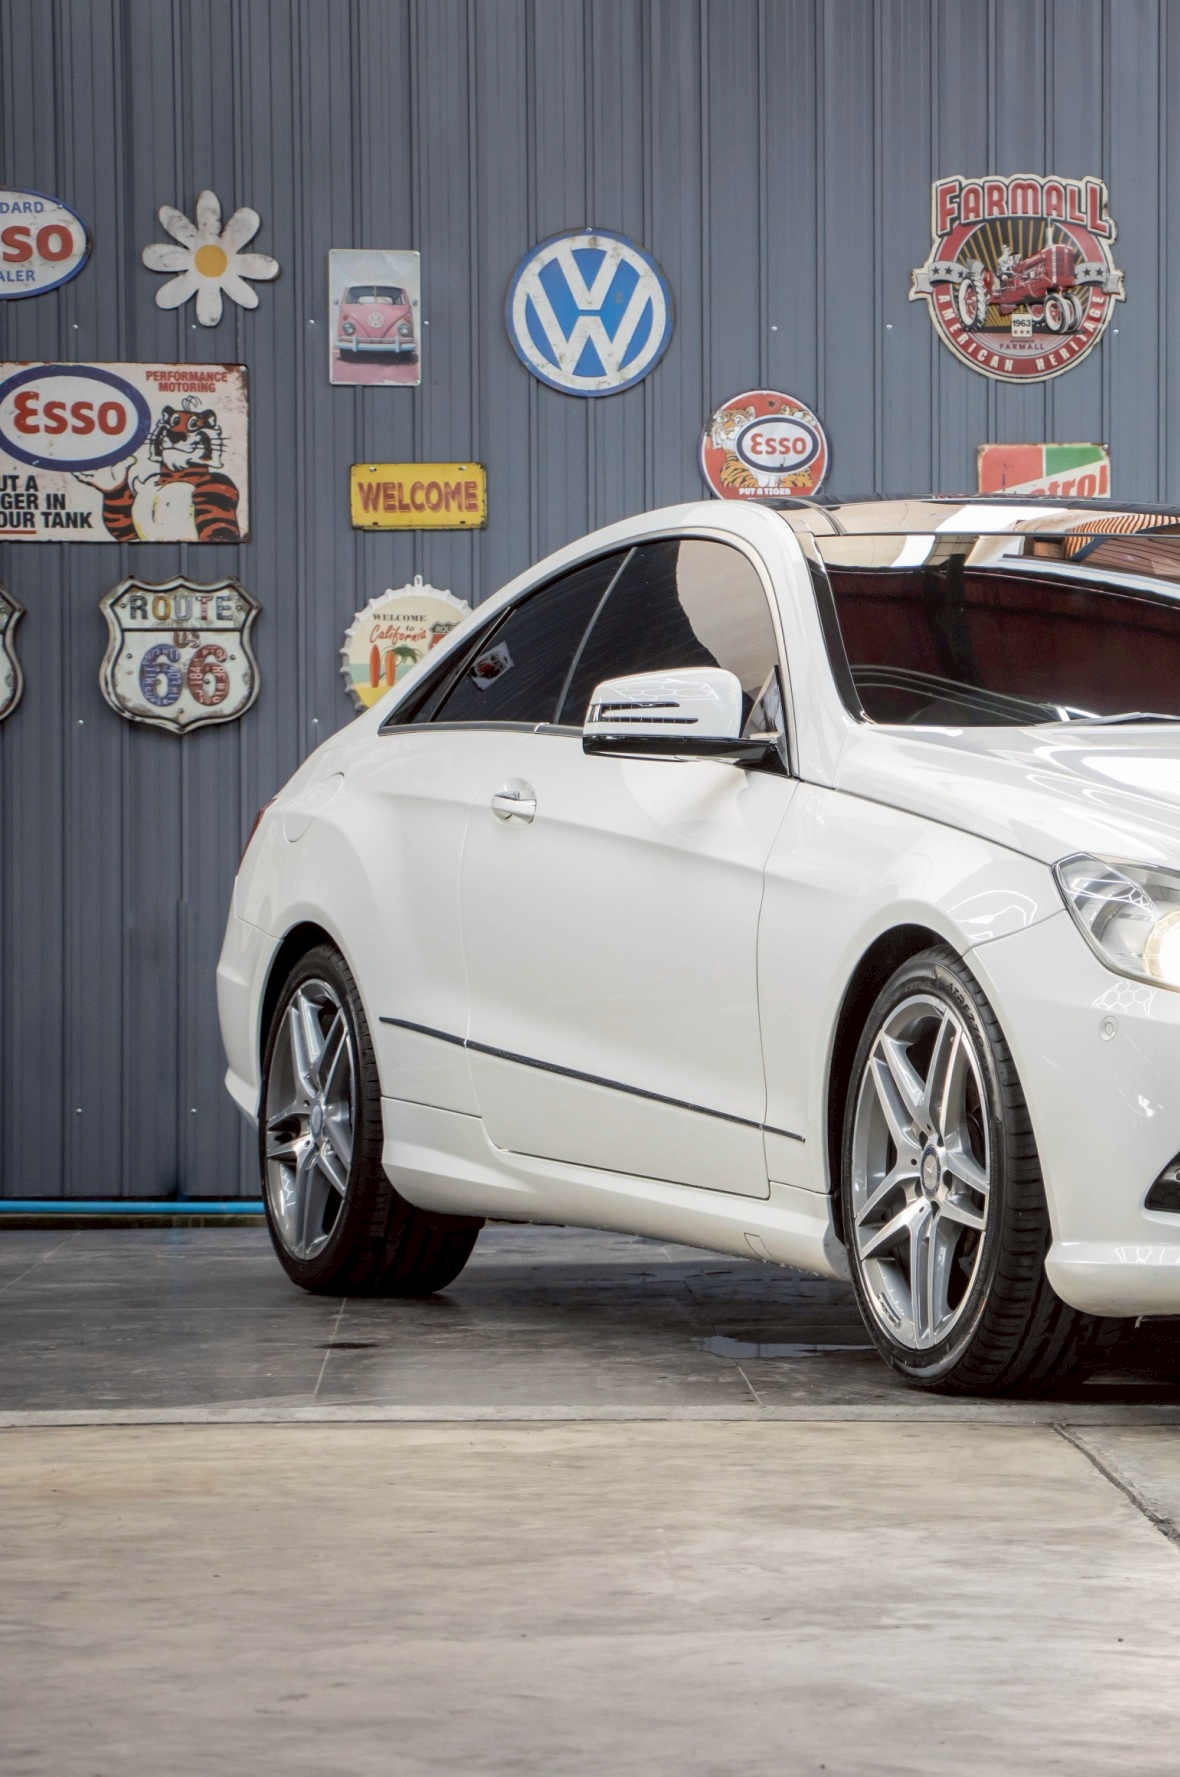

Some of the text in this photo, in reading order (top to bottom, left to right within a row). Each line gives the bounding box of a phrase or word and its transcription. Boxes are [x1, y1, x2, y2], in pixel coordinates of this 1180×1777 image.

[0, 201, 45, 214] DARD
[937, 178, 1110, 236] FARMALL
[1012, 319, 1031, 327] 1963
[938, 295, 1104, 371] AMERICAN HERITAGE
[146, 371, 228, 382] PERFORMANCE
[158, 382, 216, 393] MOTORING
[25, 475, 38, 492] A
[739, 487, 755, 495] PUT
[764, 487, 791, 495] TIGER
[46, 493, 66, 510] IN
[358, 481, 479, 514] WELCOME
[41, 511, 93, 528] TANK
[130, 595, 233, 621] ROUTE
[373, 613, 426, 622] WELCOME
[173, 631, 201, 649] US
[369, 623, 427, 646] California
[139, 643, 230, 707] 66
